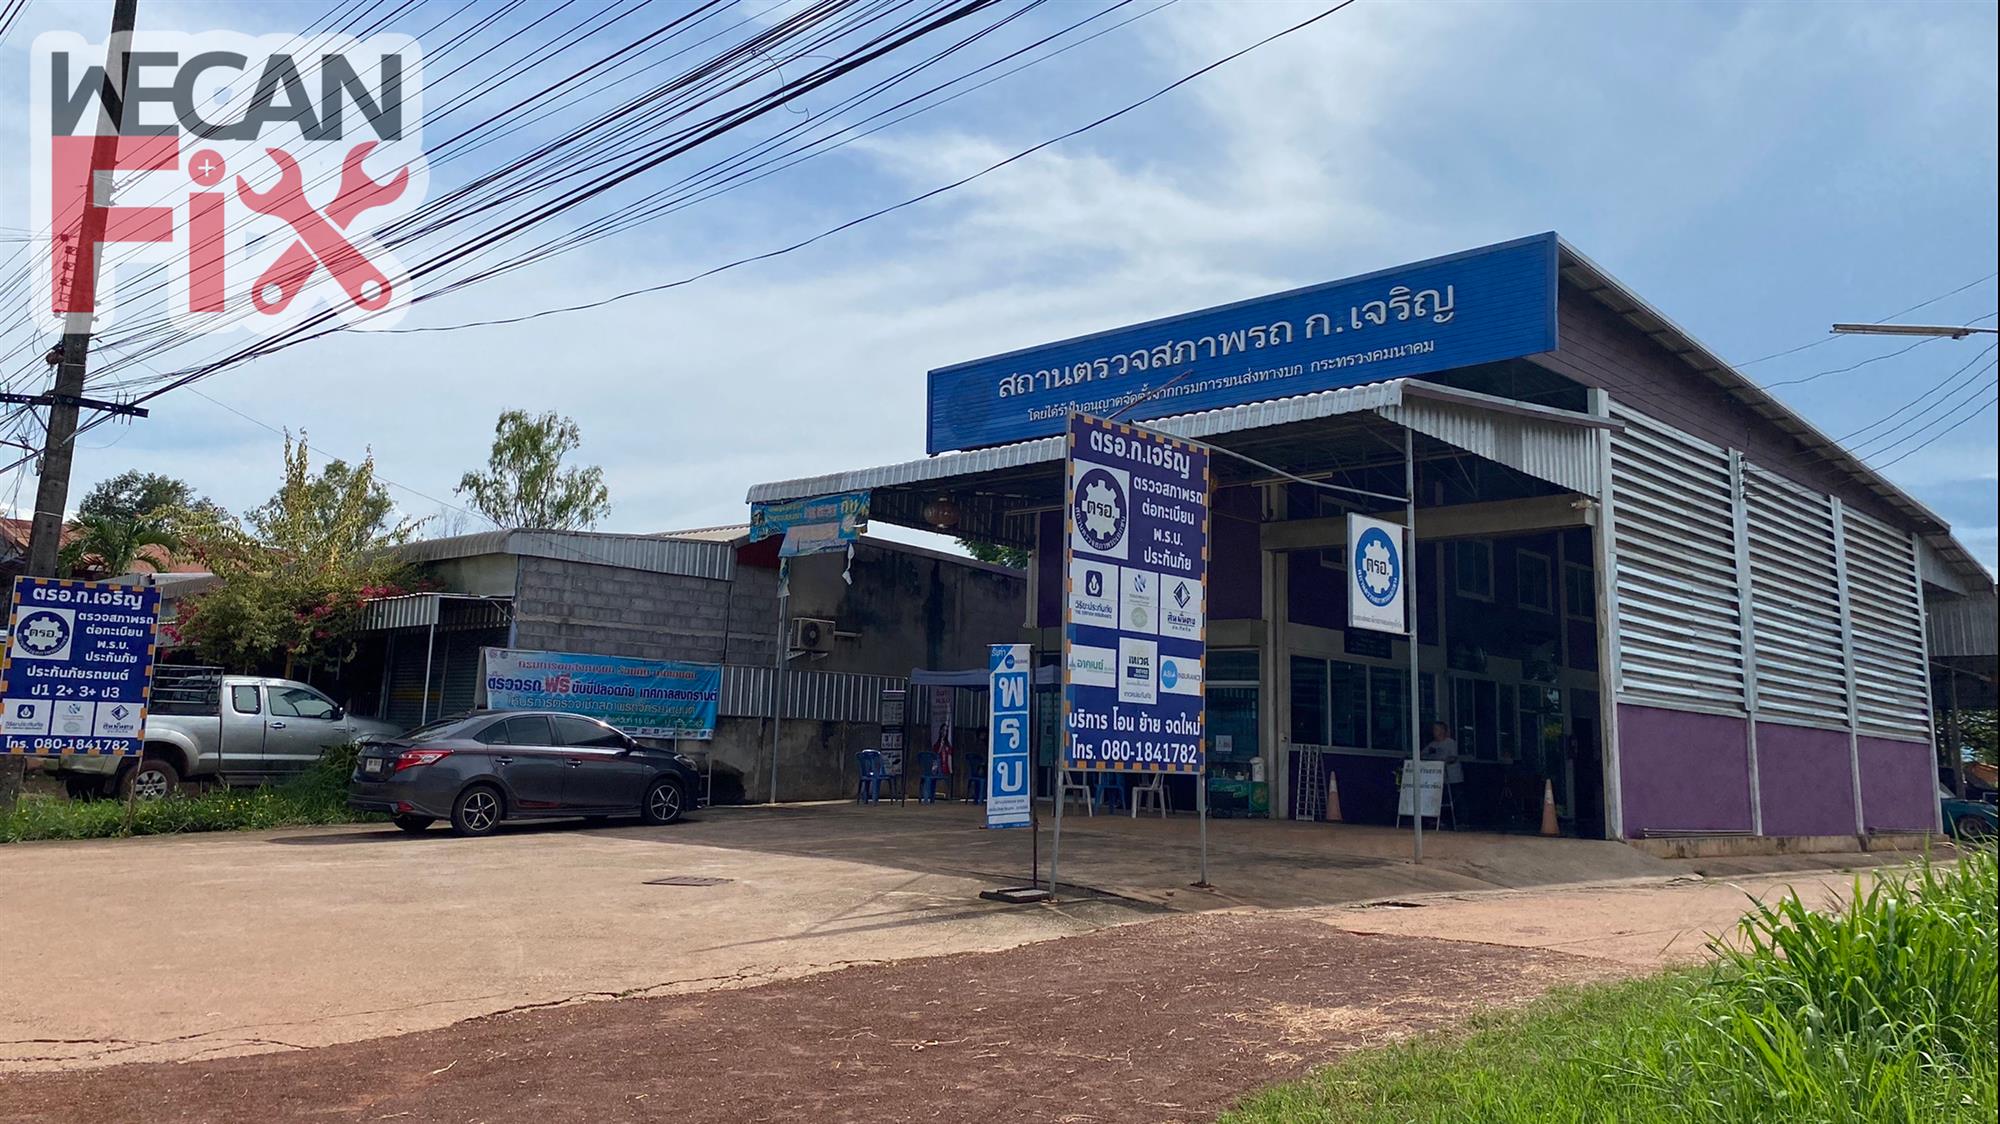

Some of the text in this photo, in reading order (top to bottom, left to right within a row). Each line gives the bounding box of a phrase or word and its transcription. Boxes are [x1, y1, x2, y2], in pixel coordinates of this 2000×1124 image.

[999, 284, 1455, 398] สถานตรวจสภาพรถ ก.เจริญ
[1310, 339, 1435, 373] กระทรวงคมนาคม
[1090, 429, 1190, 479] ตรอ.ก.เจริญ
[1134, 476, 1203, 504] ตรวจสภาพรถ
[1087, 500, 1115, 519] ตรอ.
[1142, 498, 1195, 525] ต่อทะเบียน
[1154, 527, 1183, 546] พ.ร.บ.
[1144, 546, 1192, 571] ประกันภัย
[1366, 558, 1390, 576] ตรอ.
[32, 586, 143, 610] ตรอ.ก.เจริญ
[78, 612, 154, 625] ตรวจสภาพรถ
[29, 627, 57, 638] ตรอ.
[86, 623, 144, 638] ต่อทะเบียน
[97, 640, 129, 650] พ.ร.บ.
[85, 651, 138, 663] ประกันภัย
[27, 664, 129, 681] ประกันภัยรถยนต์
[31, 683, 120, 698] ป1 2+ 3+ ป3
[1069, 706, 1200, 736] บริการ โอน ย้าย จดใหม่
[6, 735, 129, 751] โทร. 080-1841782
[1072, 733, 1096, 759] โทร.
[1102, 739, 1197, 763] 080-1841782
